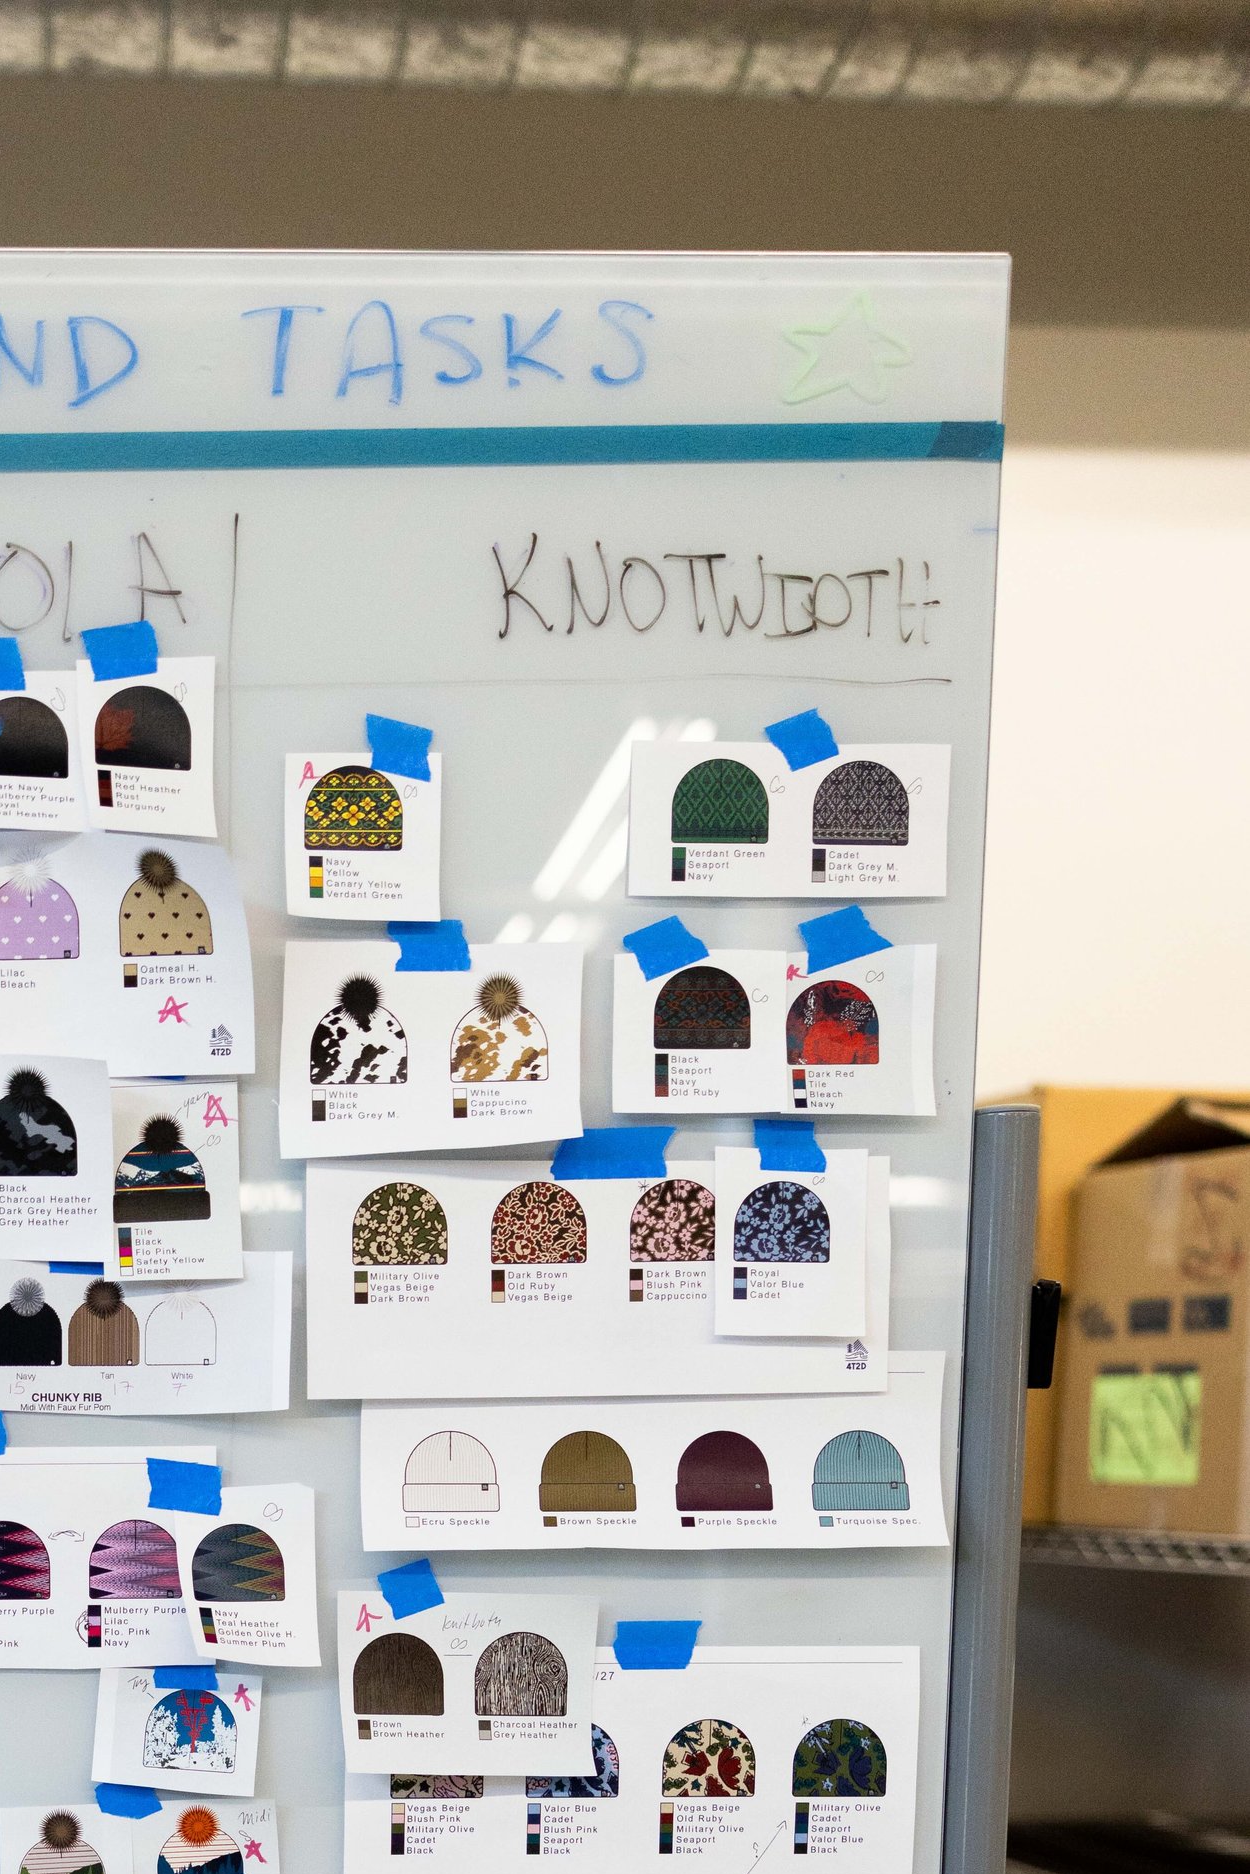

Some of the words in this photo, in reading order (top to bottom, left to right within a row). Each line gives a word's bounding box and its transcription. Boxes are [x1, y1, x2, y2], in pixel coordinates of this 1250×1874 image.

[243, 299, 661, 407] TASKS
[688, 849, 729, 858] Verdant
[733, 849, 766, 858] Green
[325, 857, 352, 870] Navy
[687, 860, 729, 873] Seaport
[325, 868, 360, 877] Yellow
[325, 879, 363, 892] Canary
[367, 880, 402, 889] Yellow
[0, 968, 26, 978] Lilac
[140, 964, 184, 974] Oatmeal
[0, 980, 36, 989] Bleach
[140, 976, 165, 986] Dark
[169, 975, 201, 985] Brown
[210, 1047, 232, 1057] 4T2D
[469, 1089, 501, 1097] White
[369, 1272, 409, 1284] Military
[412, 1271, 440, 1281] Olive
[750, 1268, 780, 1281] Royal
[369, 1283, 402, 1296] Vegas
[405, 1283, 435, 1295] Beige
[507, 1282, 525, 1291] Old
[529, 1281, 556, 1294] Ruby
[749, 1279, 777, 1289] Valor
[781, 1280, 805, 1289] Blue
[749, 1290, 781, 1299] Cadet
[15, 1372, 37, 1384] Navy
[99, 1371, 115, 1380] Tan
[170, 1371, 194, 1380] White
[31, 1392, 80, 1403] CHUNKY
[83, 1392, 103, 1403] RIB
[20, 1403, 37, 1413] Midi
[38, 1403, 56, 1413] With
[58, 1403, 76, 1413] Faux
[78, 1403, 91, 1413] Fur
[94, 1403, 111, 1413] Pom
[421, 1517, 445, 1526] Ecru
[449, 1517, 490, 1529] Speckle
[559, 1517, 592, 1526] Brown
[596, 1517, 637, 1528] Speckle
[698, 1517, 732, 1529] Purple
[736, 1517, 778, 1529] Speckle
[835, 1517, 888, 1528] Turquoise
[406, 1814, 435, 1823] Blush
[439, 1814, 461, 1823] Pink
